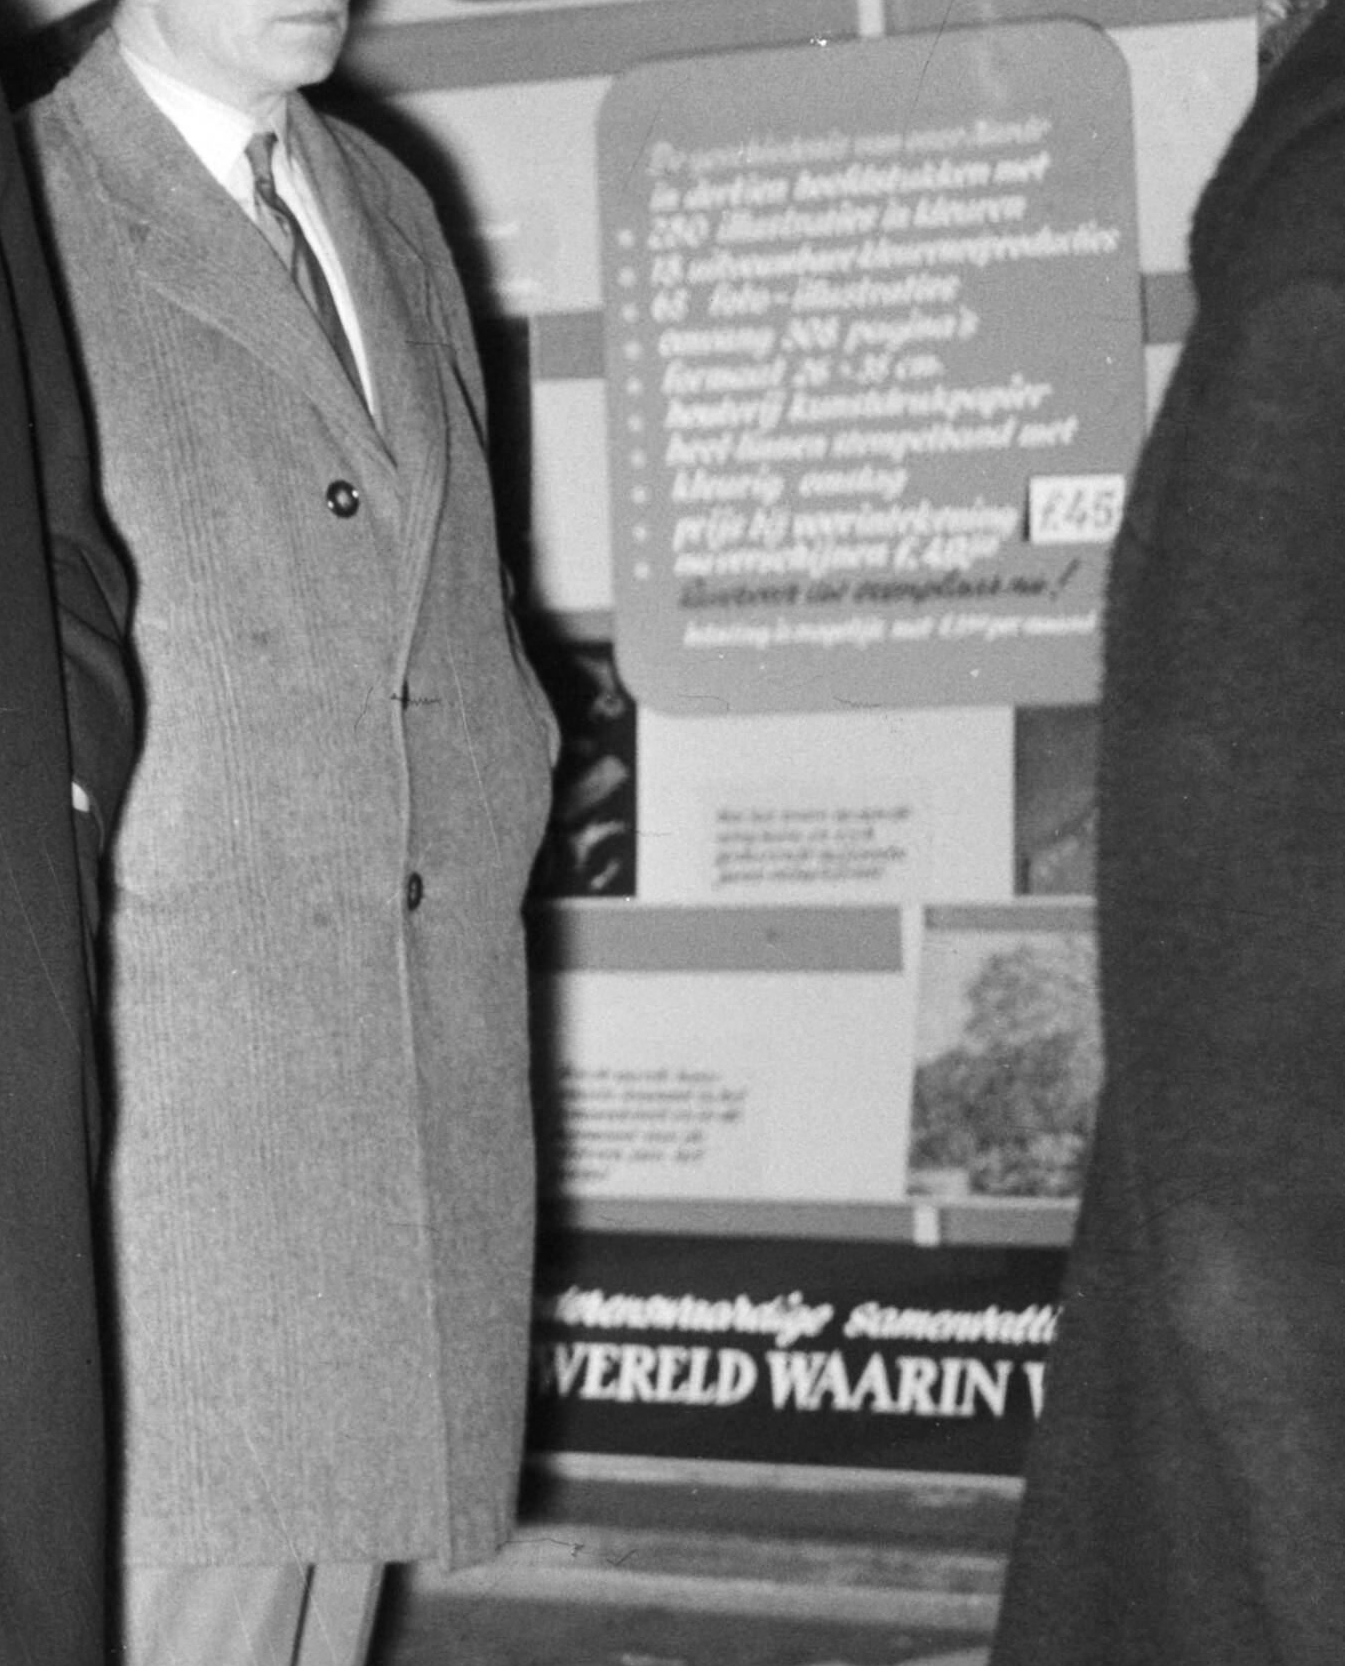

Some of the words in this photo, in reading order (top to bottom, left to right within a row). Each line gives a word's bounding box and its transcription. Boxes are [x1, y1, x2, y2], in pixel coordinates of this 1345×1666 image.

[992, 149, 1051, 184] met
[1016, 414, 1079, 448] met
[764, 1347, 1014, 1420] WAARIN
